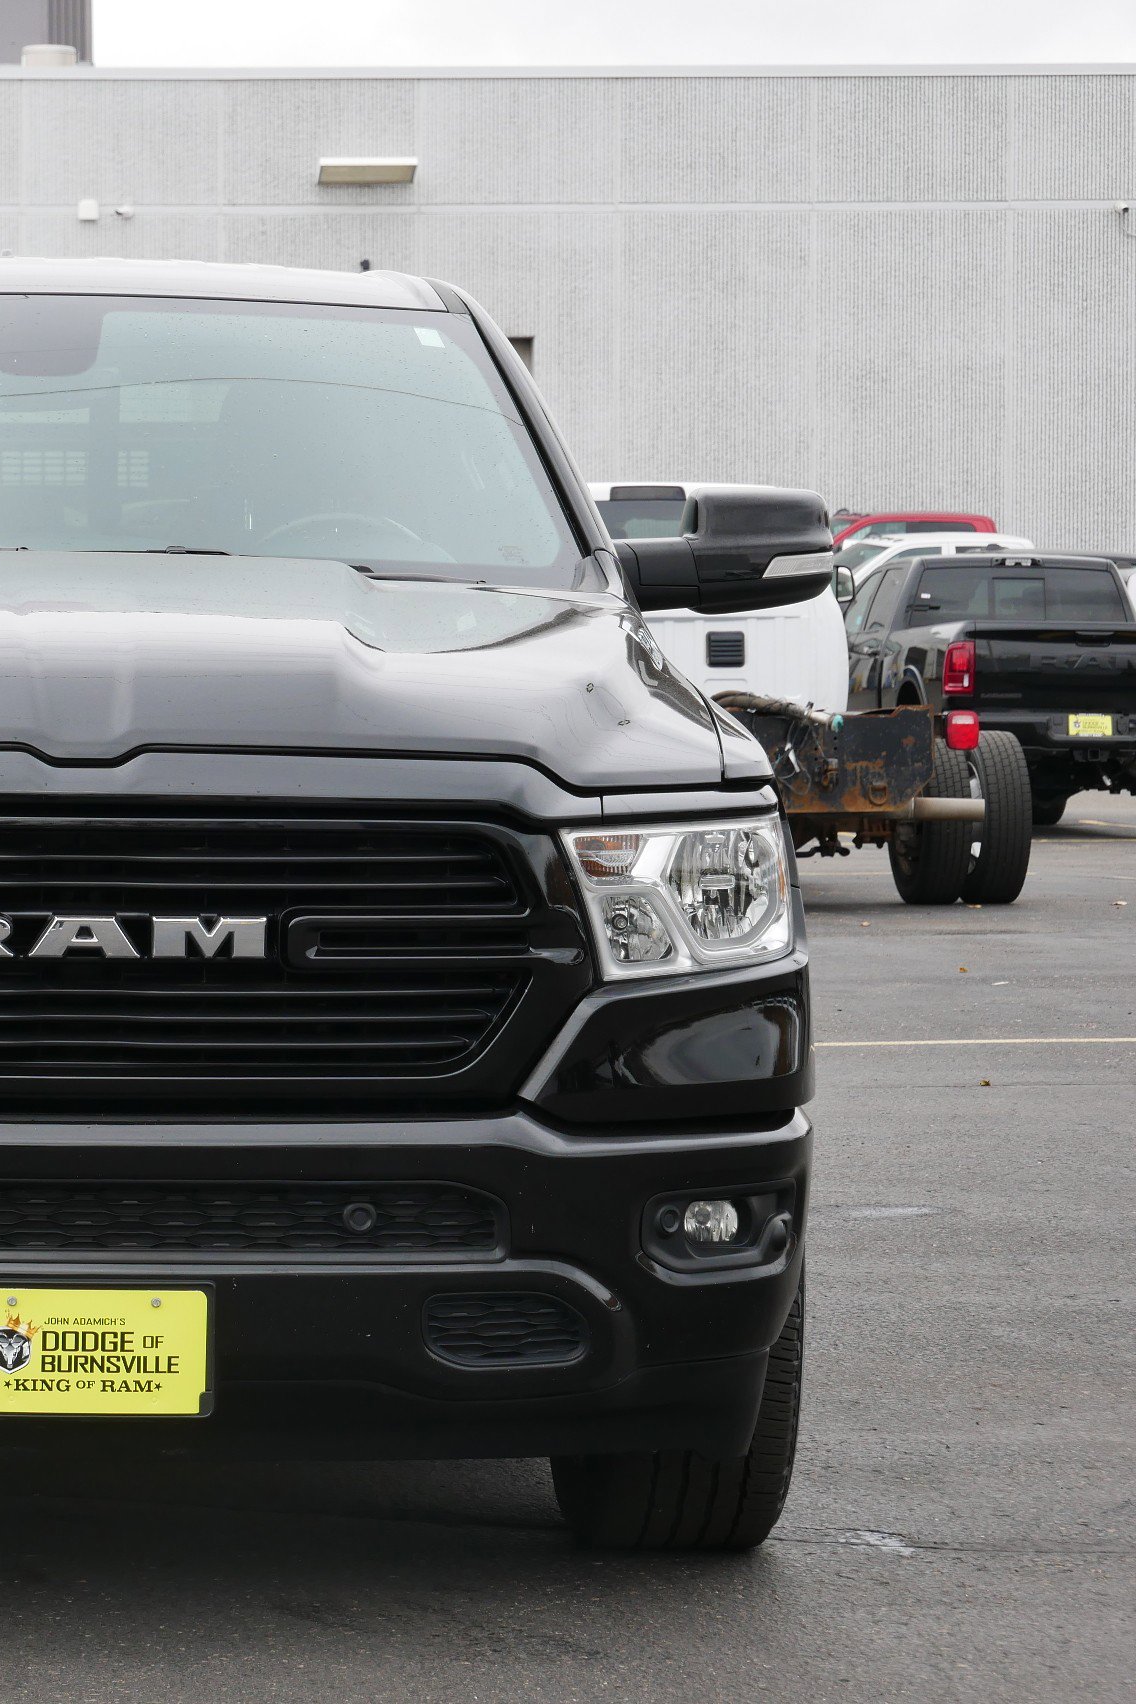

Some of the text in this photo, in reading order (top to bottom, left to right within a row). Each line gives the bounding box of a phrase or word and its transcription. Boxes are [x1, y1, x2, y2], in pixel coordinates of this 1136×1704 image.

[44, 1317, 126, 1326] JOHN ADAMICH'S
[41, 1330, 165, 1353] DODGE OF
[40, 1354, 180, 1374] BURNSVILLE
[13, 1378, 154, 1393] KING OF RAM
